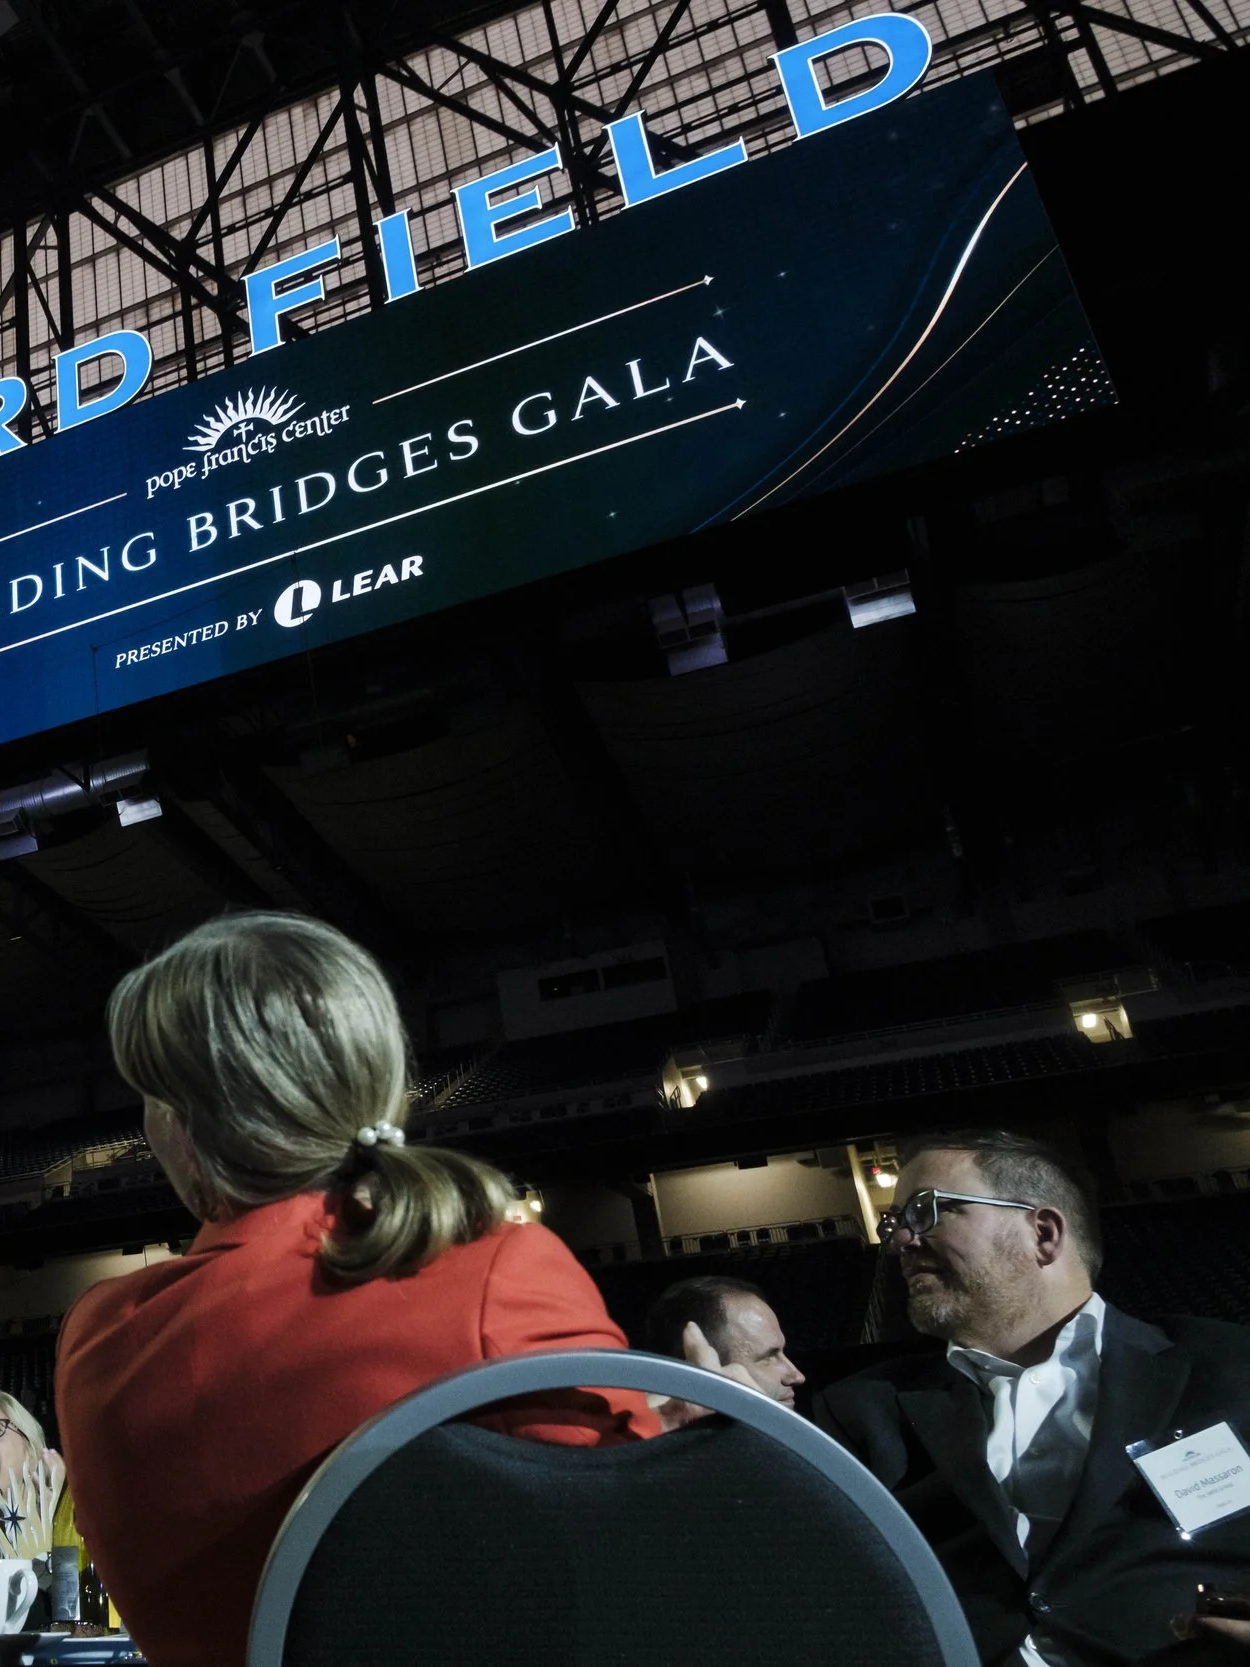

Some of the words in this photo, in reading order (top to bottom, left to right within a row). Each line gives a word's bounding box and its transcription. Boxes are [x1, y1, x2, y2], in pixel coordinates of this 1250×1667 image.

[241, 12, 933, 358] FIELD
[145, 462, 197, 500] pope
[201, 432, 277, 480] francis
[281, 404, 351, 443] center
[186, 419, 479, 553] BRIDGES
[511, 336, 735, 436] GALA
[115, 620, 229, 669] PRESENTED
[235, 608, 263, 631] BY
[331, 555, 424, 603] LEAR
[1174, 1482, 1200, 1499] David
